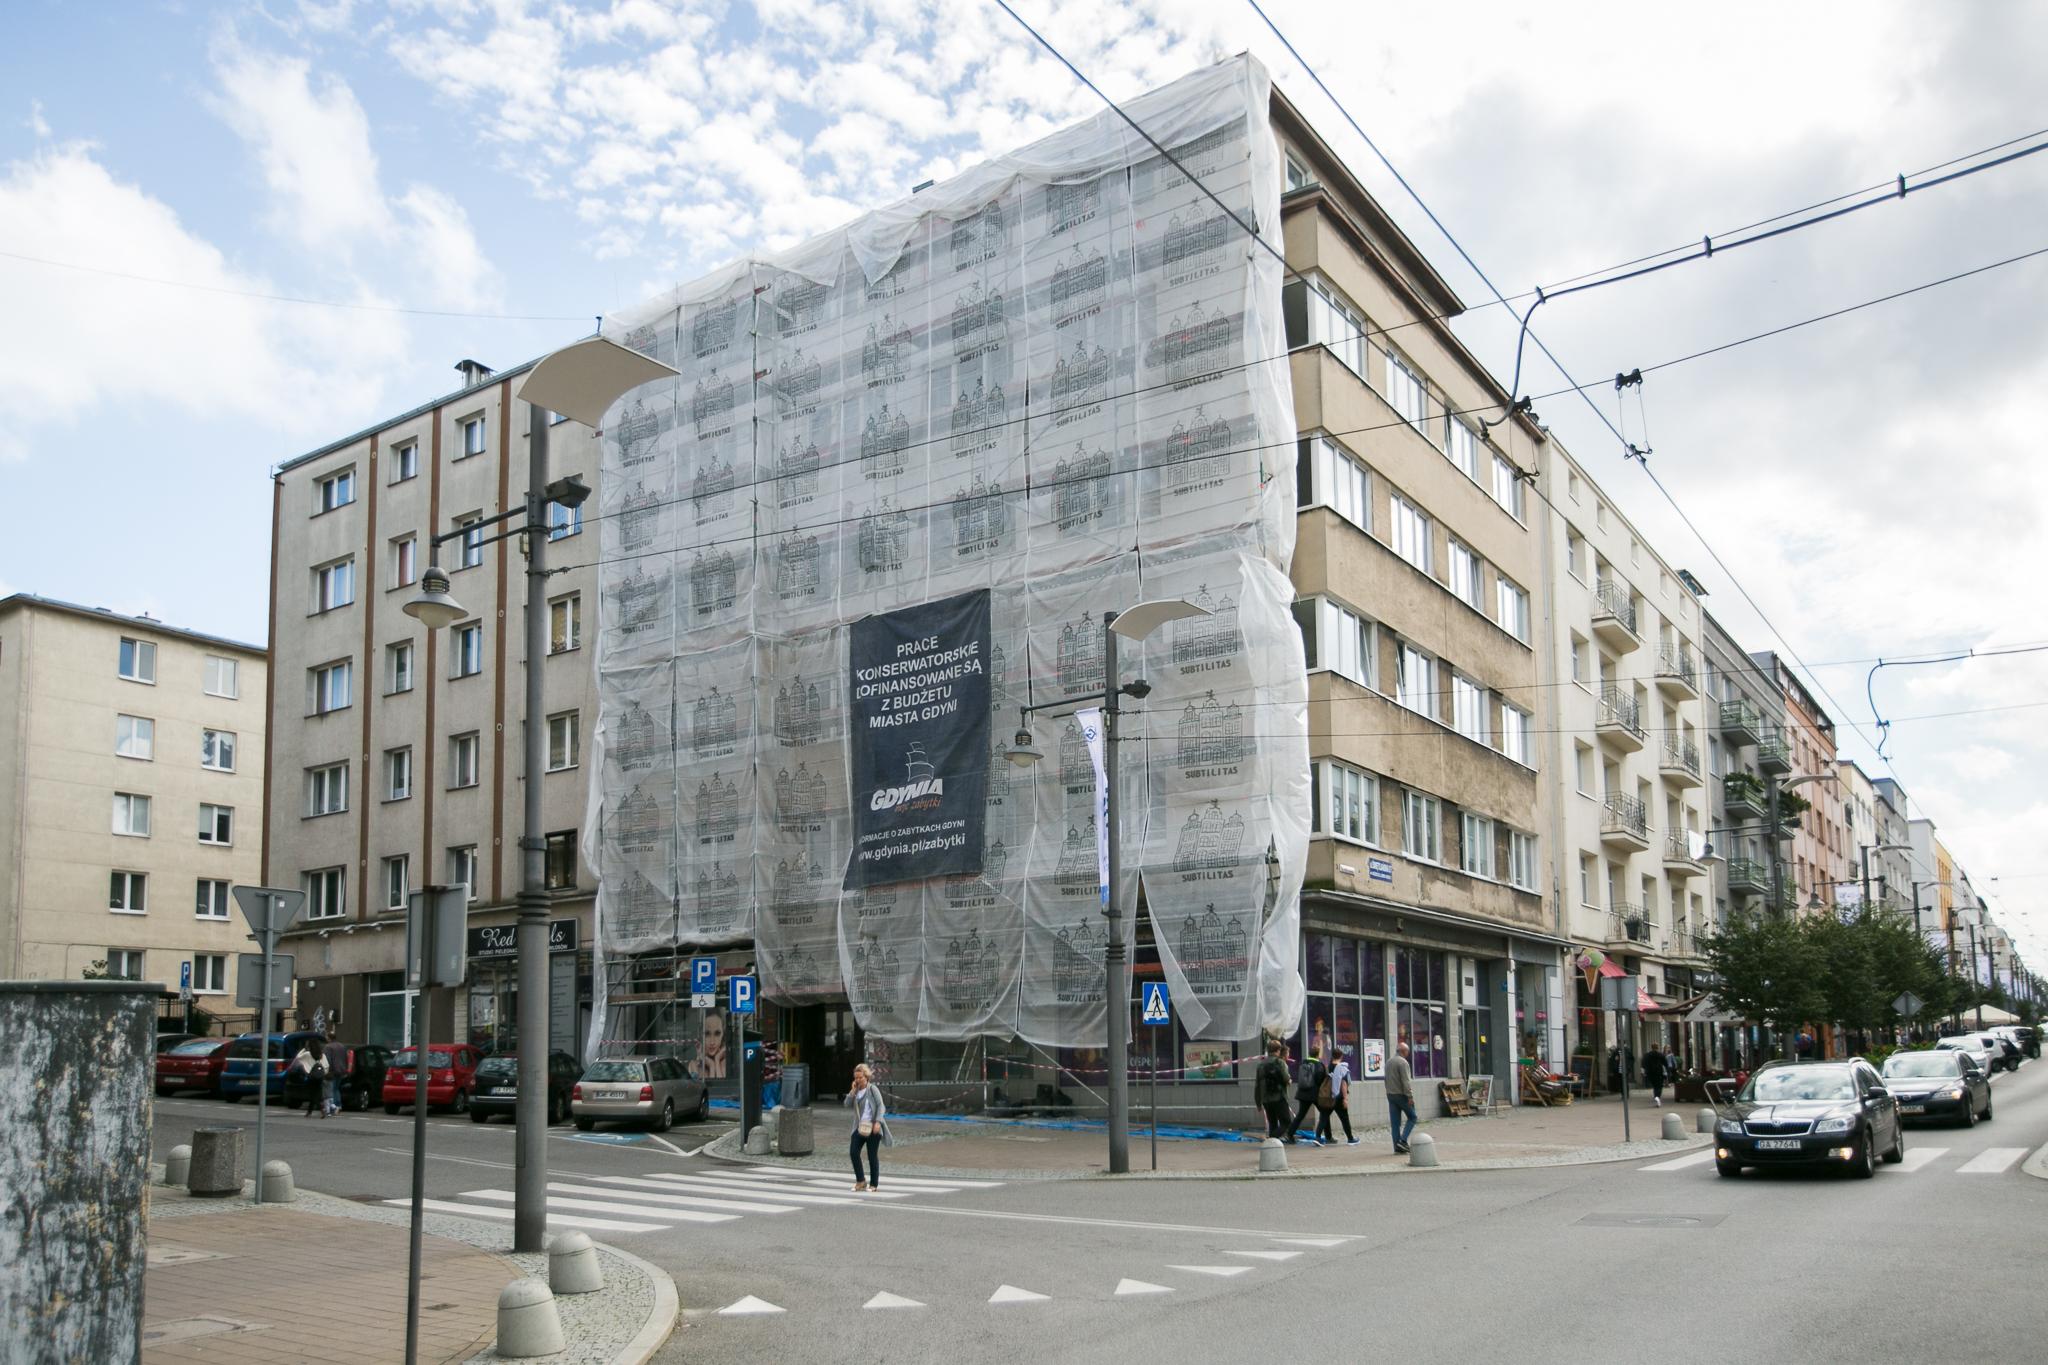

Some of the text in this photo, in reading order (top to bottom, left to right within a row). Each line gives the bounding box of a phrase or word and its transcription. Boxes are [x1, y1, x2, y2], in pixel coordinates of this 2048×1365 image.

[1166, 167, 1215, 190] SUBTIITAS
[1051, 212, 1096, 237] SUBTILITAS
[955, 252, 997, 272] SUBTILITAS
[1169, 266, 1220, 286] SUBTILITAS
[868, 287, 906, 301] SUBTILITAS
[1056, 307, 1101, 329] SUBTILITAS
[782, 324, 817, 339] SUBTILITAS
[958, 345, 999, 364] SUBTILITAS
[867, 375, 906, 389] SUBTILITAS
[1056, 406, 1101, 428] SUBTILITAS
[956, 442, 997, 458] SUBTILITAS
[864, 468, 904, 480] SUBTILITAS
[1173, 479, 1224, 497] SUBTILITAS
[779, 497, 814, 509] SUBTILITAS
[695, 513, 729, 527] SUBTILITAS
[1058, 511, 1103, 532] SUBTILITAS
[957, 540, 999, 554] SUBTILITAS
[779, 588, 815, 599] SUBTILITAS
[698, 602, 732, 615] SUBTILITAS
[897, 636, 939, 657] PRACE
[856, 641, 979, 681] KONSERWATORSKIE
[963, 659, 983, 674] SĄ
[1180, 660, 1232, 675] SUBTILITAS
[1062, 683, 1105, 696] SUBTILITA
[881, 685, 952, 711] Z BUDŻETU
[869, 699, 958, 728] MIASTA GDYNI
[1185, 766, 1239, 779] SUBTILITAS
[870, 779, 943, 811] GDYNIA
[1066, 785, 1097, 795] SUBTILI
[859, 820, 965, 844] ORMACJE O ZABYTKACH GDYNI
[858, 833, 966, 862] ww.gdynia.pl/zabytki
[1181, 870, 1234, 882] SUBTILITAS
[1061, 886, 1100, 896] SUBTILIT
[949, 897, 994, 909] SUBTILITAS
[482, 928, 515, 947] Red
[183, 963, 190, 980] P
[697, 961, 712, 983] P
[736, 980, 750, 1008] P
[1057, 993, 1102, 1003] SUBTILITAS
[747, 1049, 754, 1060] P
